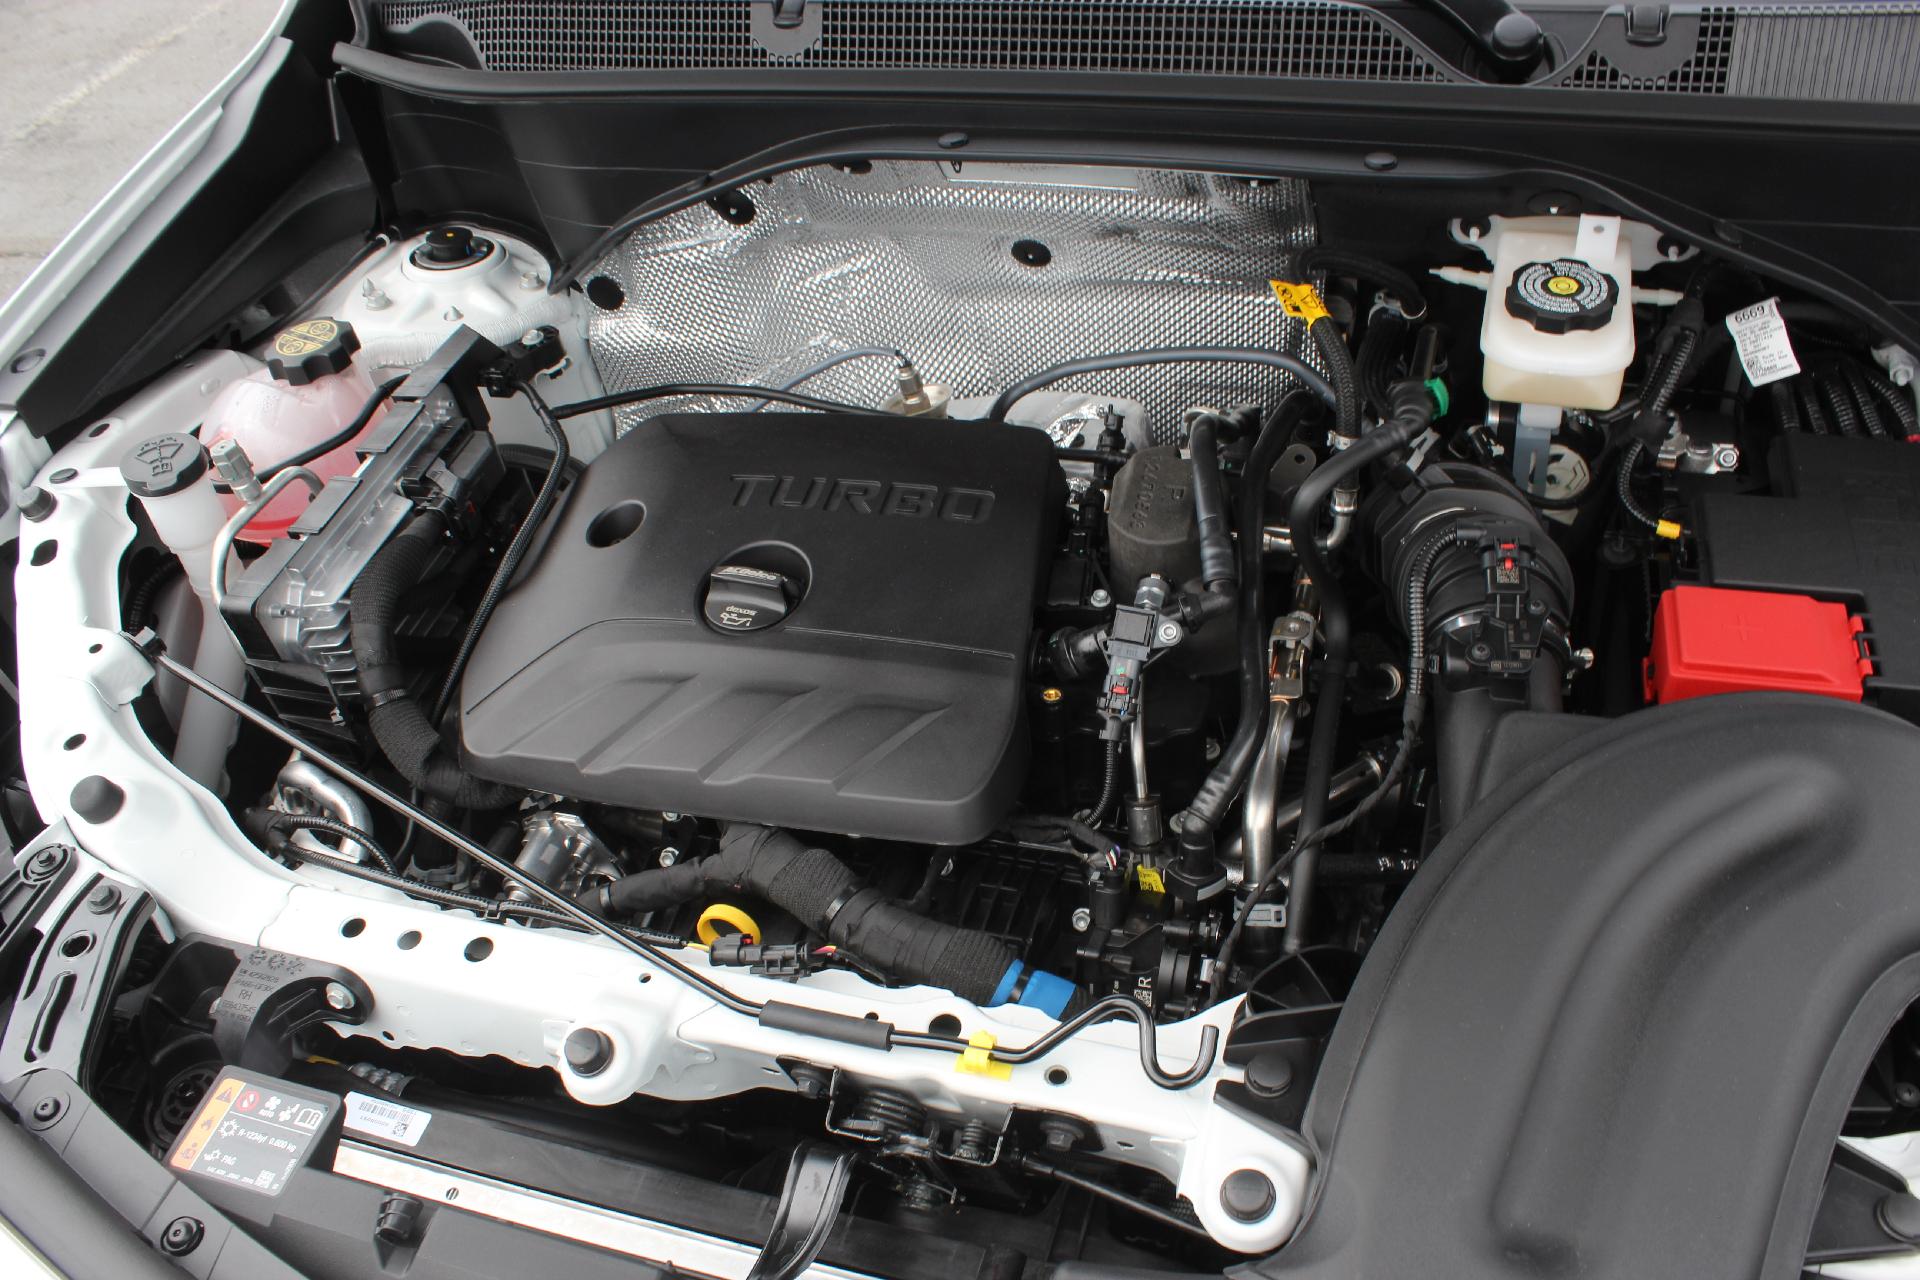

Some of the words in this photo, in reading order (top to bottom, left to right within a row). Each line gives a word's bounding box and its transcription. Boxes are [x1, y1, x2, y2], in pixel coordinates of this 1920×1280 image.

[1735, 305, 1765, 323] 6669
[730, 474, 996, 524] TURBO
[725, 605, 758, 616] dexos
[1137, 976, 1152, 989] R
[238, 988, 253, 1001] RH
